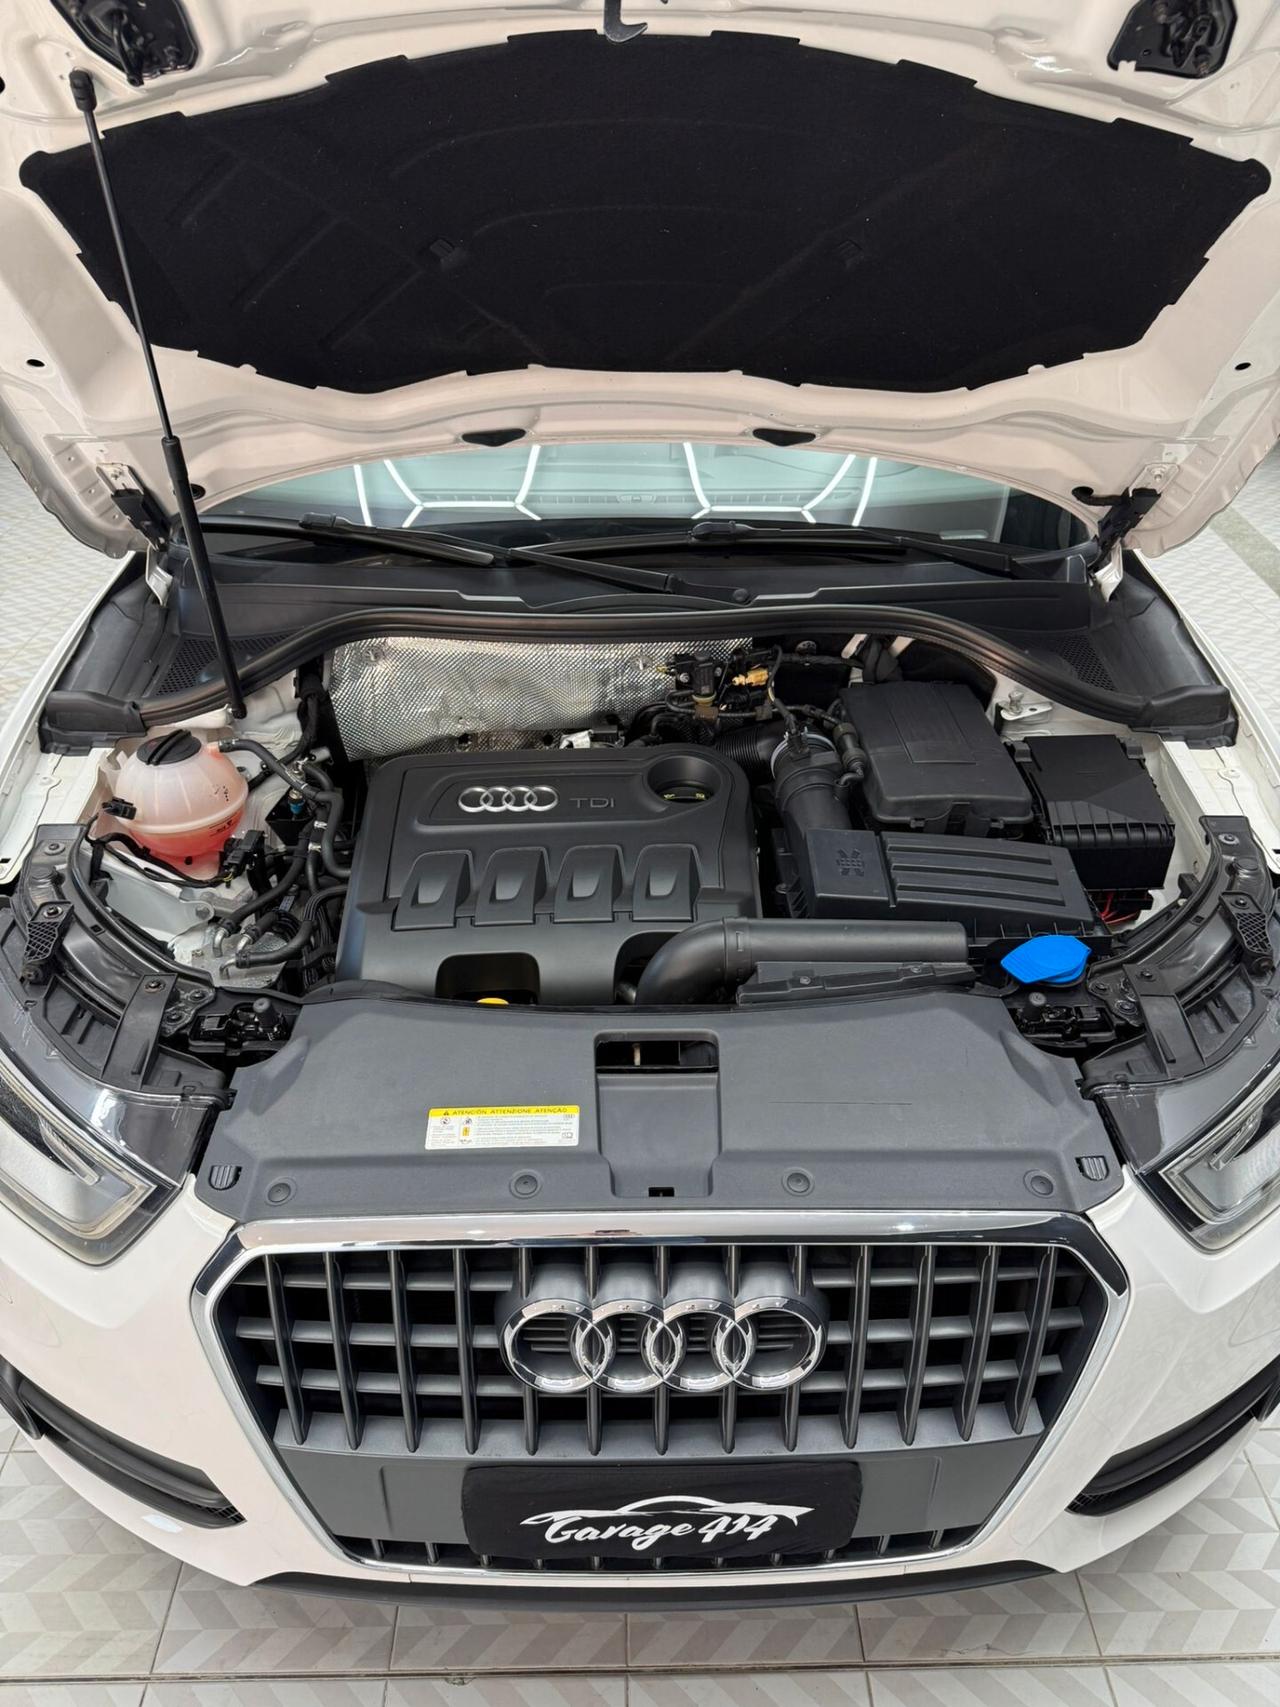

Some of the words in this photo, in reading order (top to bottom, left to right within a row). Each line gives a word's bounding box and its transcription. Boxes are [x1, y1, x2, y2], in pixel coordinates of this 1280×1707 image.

[569, 797, 614, 808] TDI
[544, 1515, 695, 1550] Garage
[698, 1515, 779, 1543] 414
